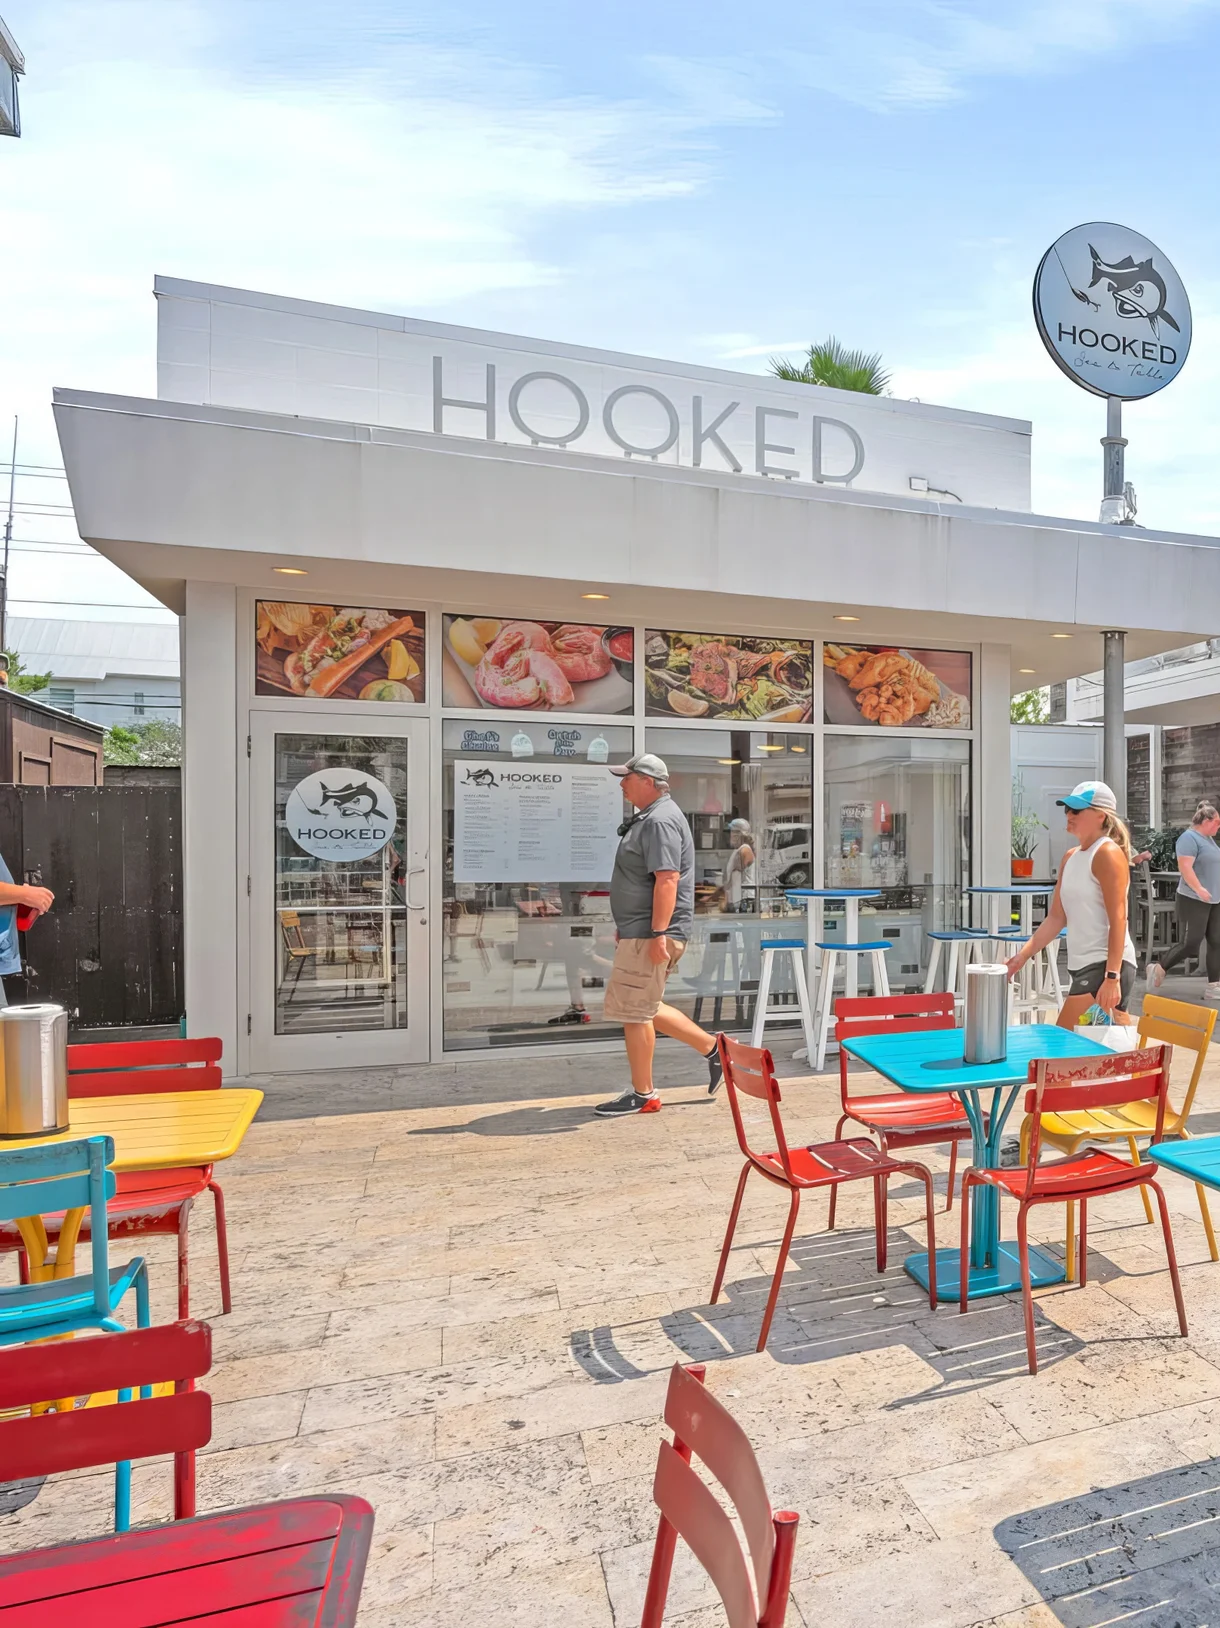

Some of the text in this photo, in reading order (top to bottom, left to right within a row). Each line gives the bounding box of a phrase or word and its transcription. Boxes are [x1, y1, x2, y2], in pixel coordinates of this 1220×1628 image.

[1058, 322, 1177, 365] HOOKED
[432, 355, 866, 484] HOOKED
[500, 773, 562, 783] HOOKED
[297, 828, 387, 839] HOOKED
